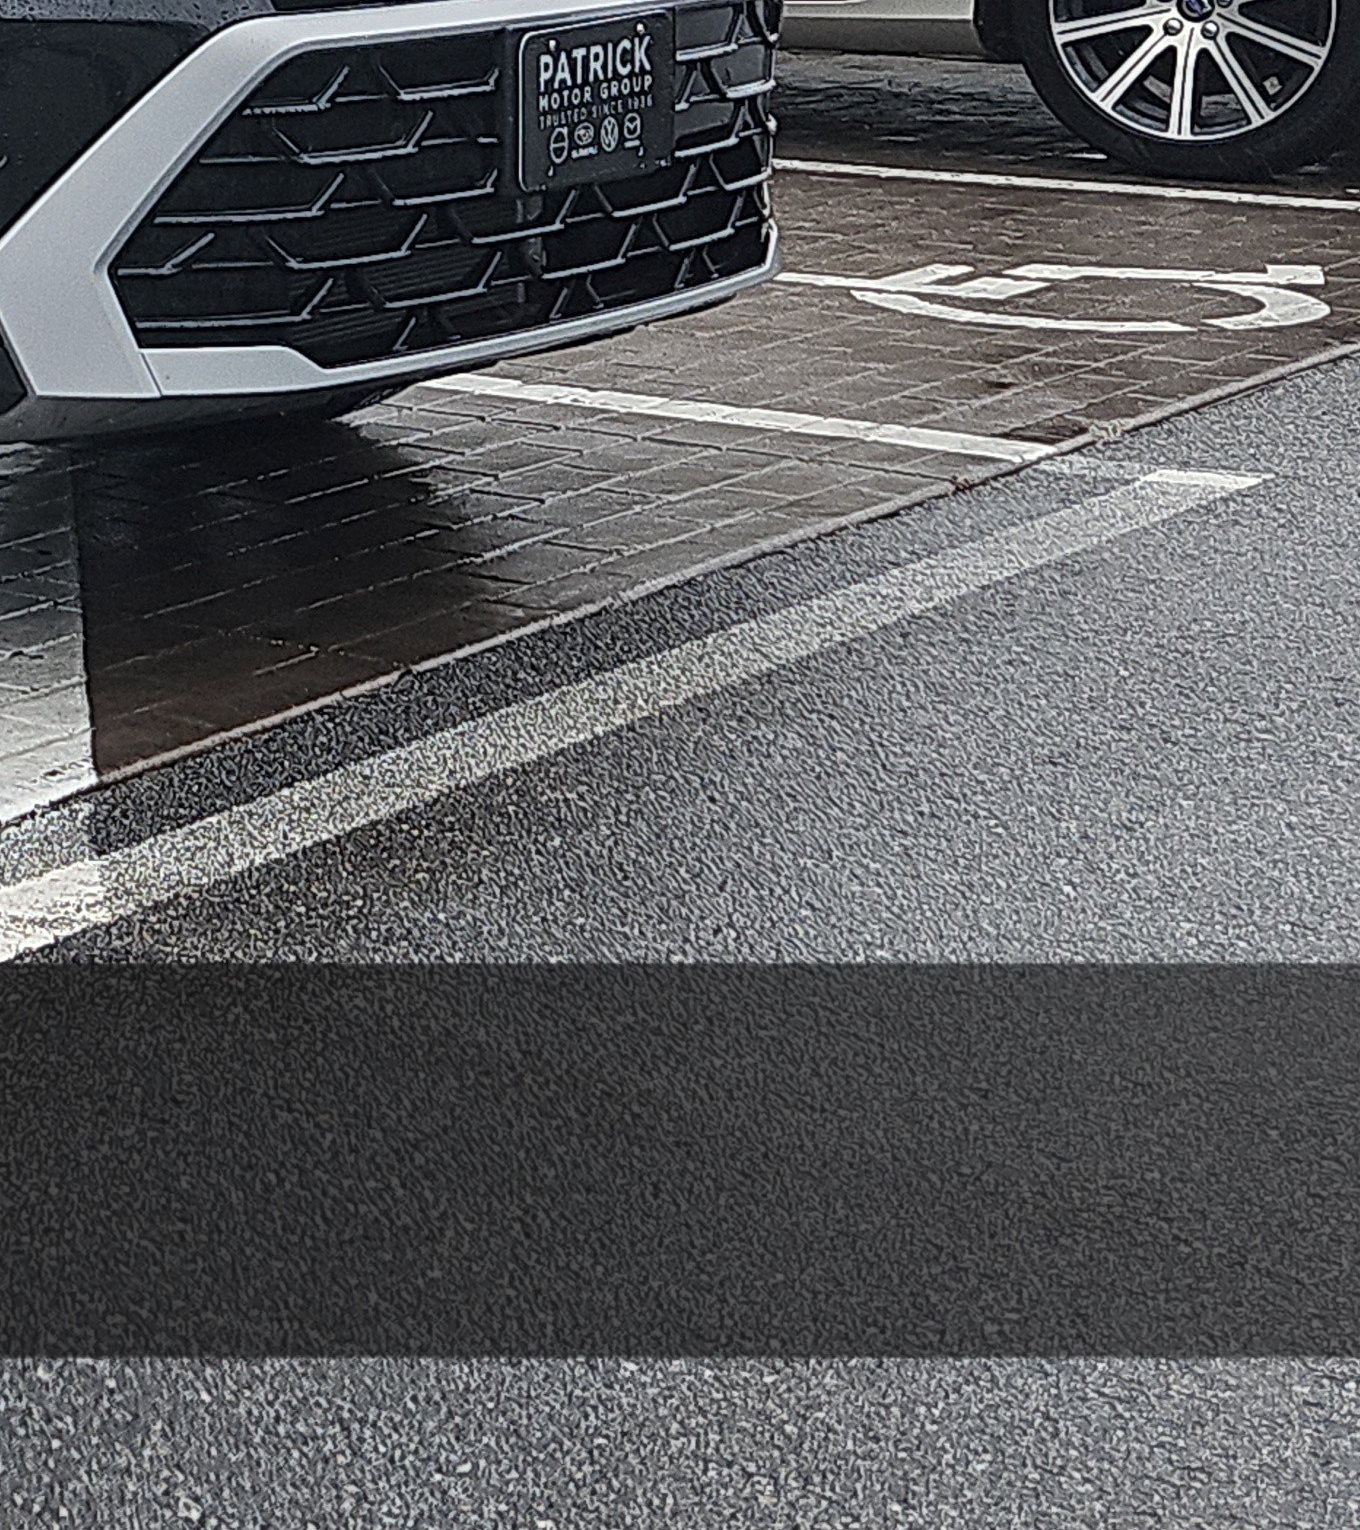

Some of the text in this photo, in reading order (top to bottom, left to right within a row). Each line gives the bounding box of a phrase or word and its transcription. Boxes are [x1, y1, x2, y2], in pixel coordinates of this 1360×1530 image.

[538, 35, 652, 92] PATRICK
[538, 74, 653, 112] MOTOR GROUP
